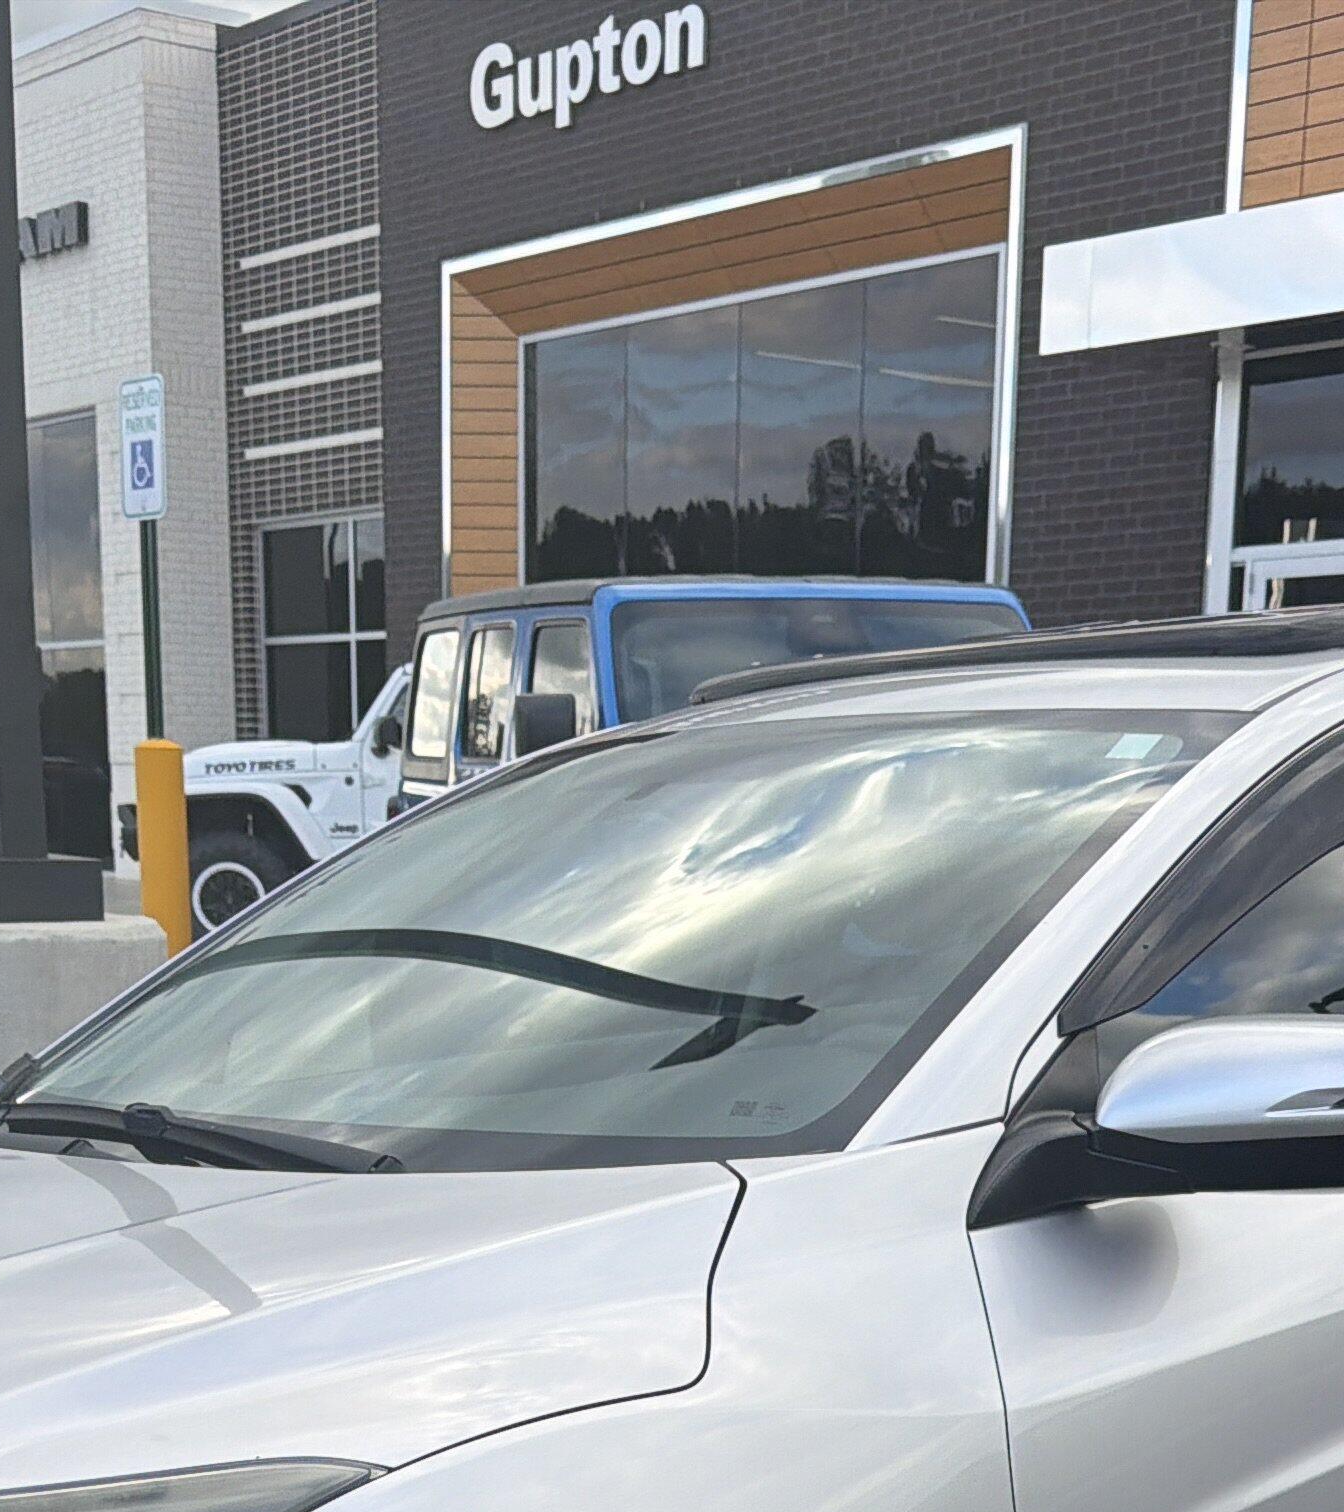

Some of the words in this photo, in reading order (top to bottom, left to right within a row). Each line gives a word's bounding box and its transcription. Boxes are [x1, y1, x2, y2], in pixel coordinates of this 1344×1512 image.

[469, 4, 705, 129] Gupton
[17, 200, 88, 261] AM
[204, 761, 246, 775] TOYO
[248, 758, 296, 774] TIRES
[327, 821, 359, 834] Jeep
